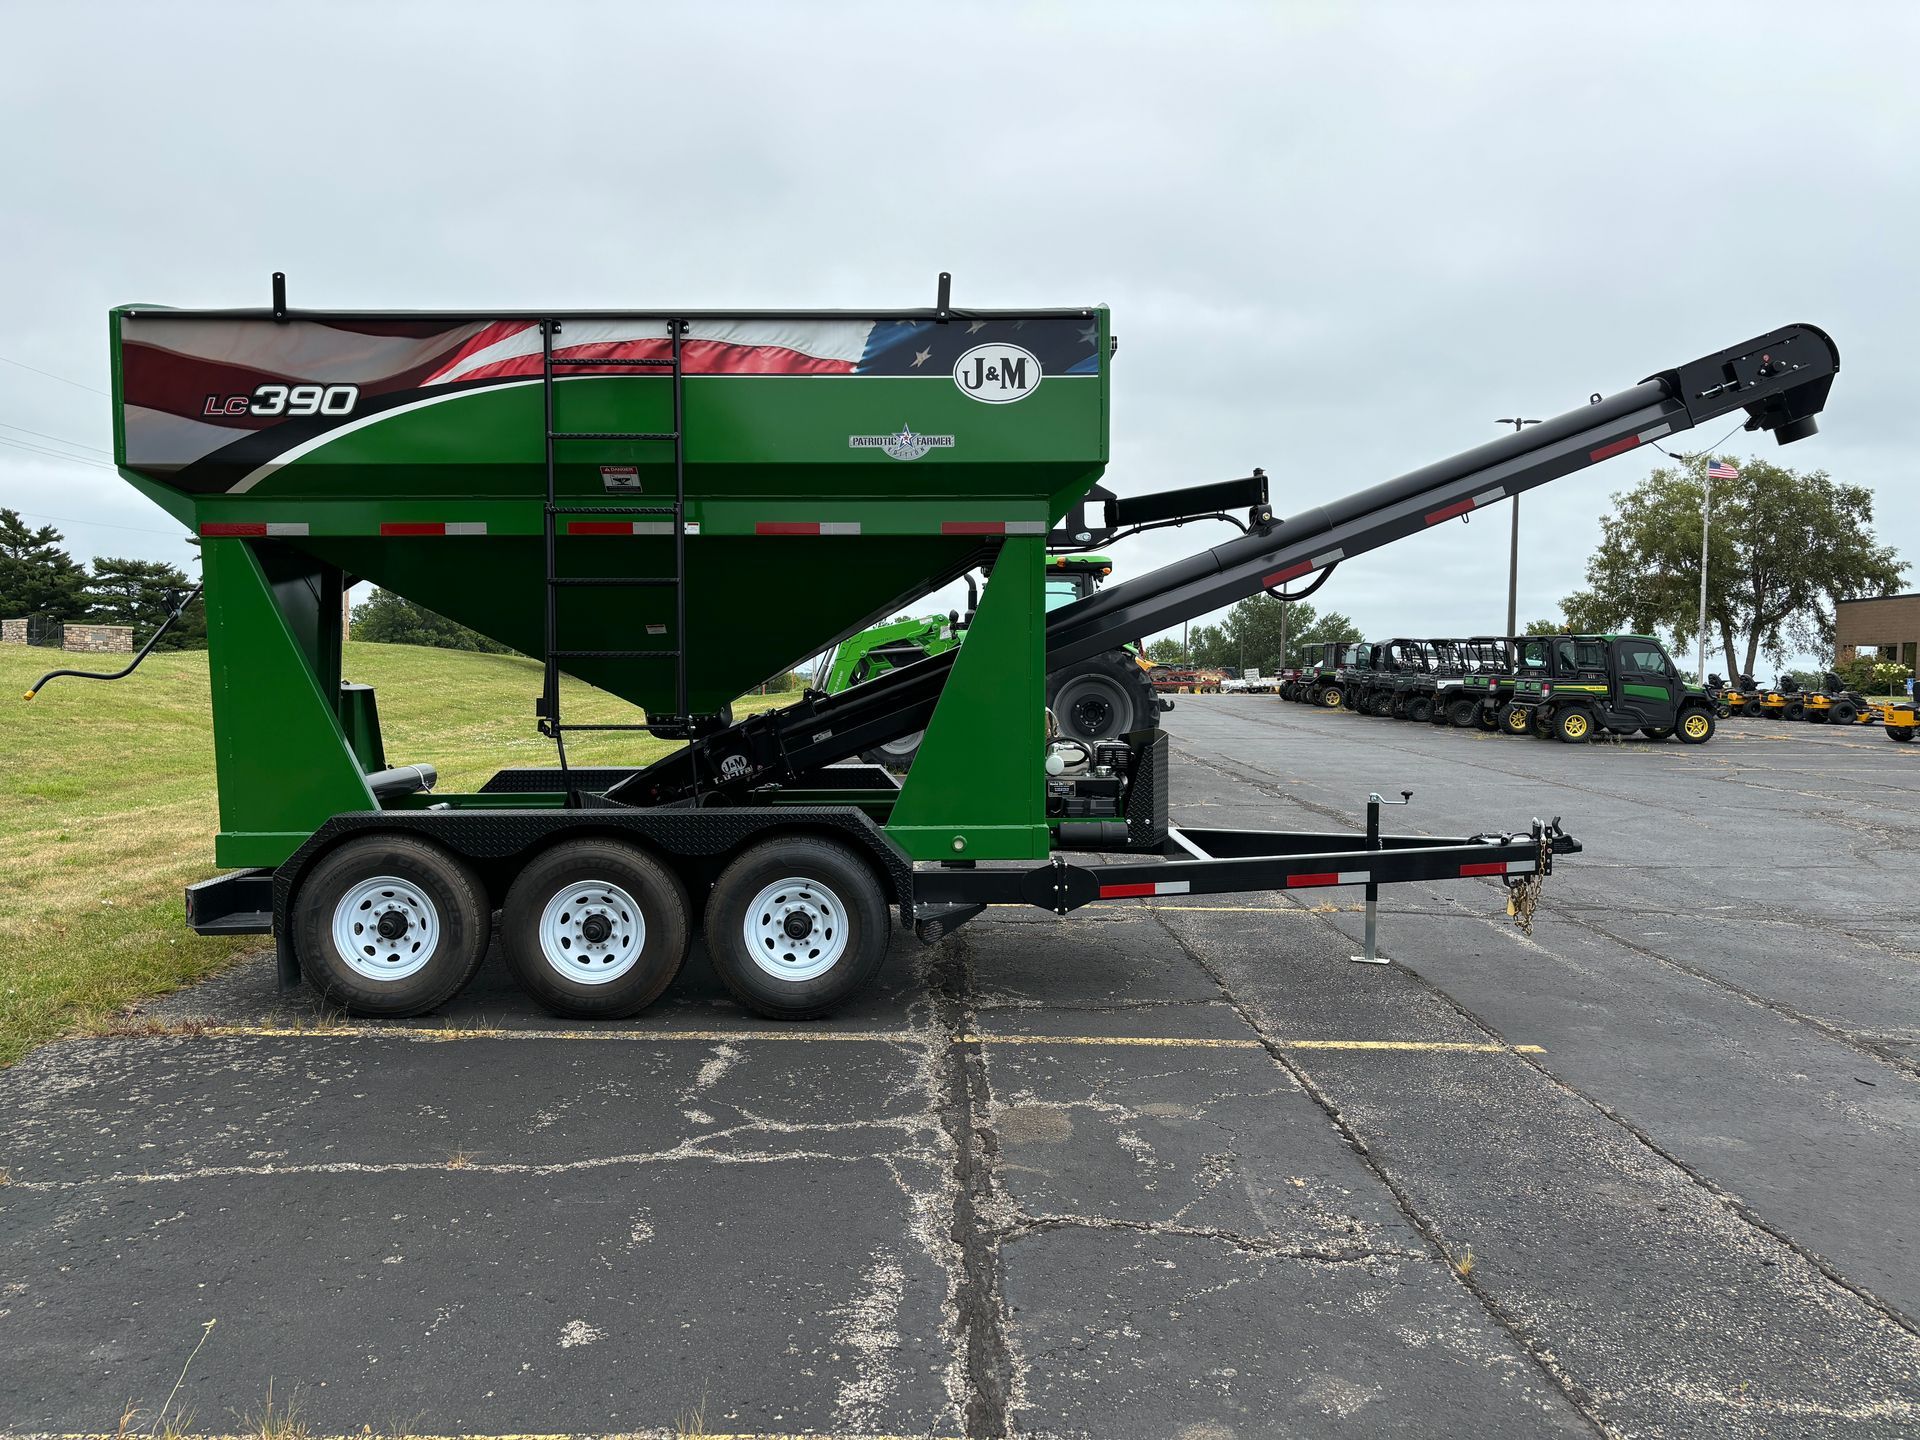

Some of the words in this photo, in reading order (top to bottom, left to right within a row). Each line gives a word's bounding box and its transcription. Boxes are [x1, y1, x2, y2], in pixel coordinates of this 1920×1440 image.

[962, 357, 1027, 390] J&M
[204, 385, 359, 415] LC390
[852, 436, 897, 446] PATRIOTIC
[916, 436, 952, 446] FARMER
[723, 756, 745, 772] J&M
